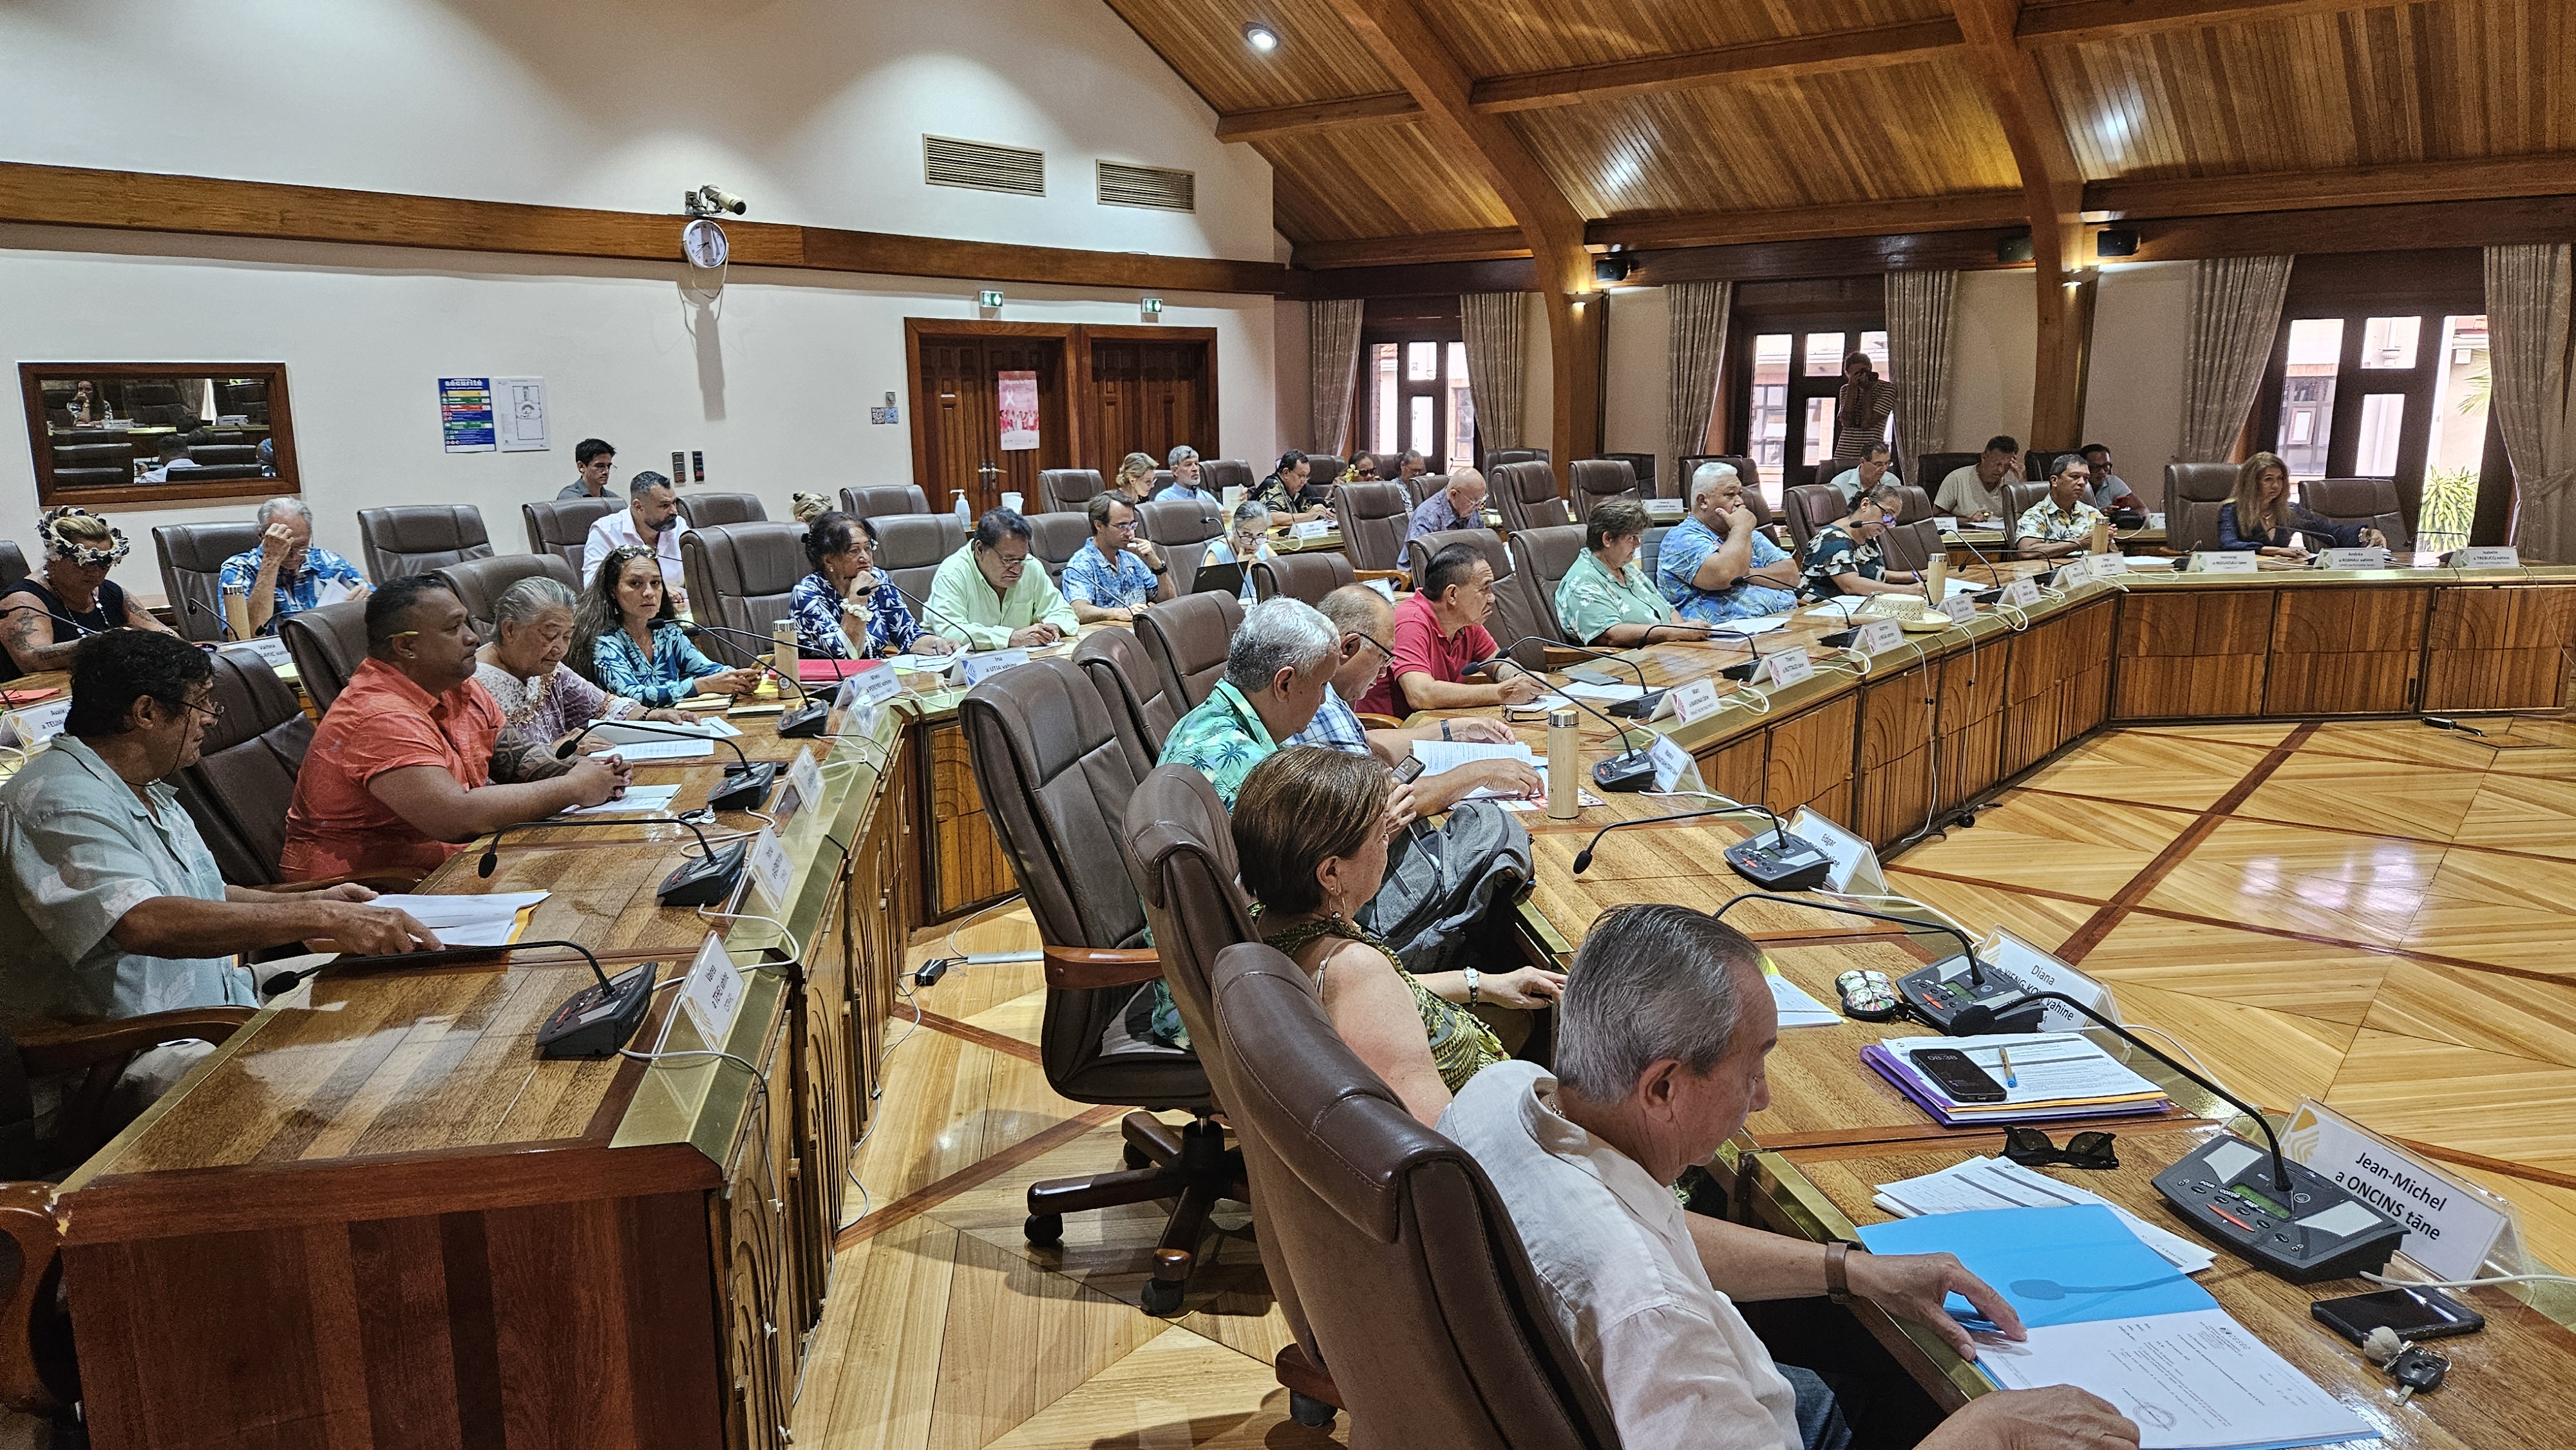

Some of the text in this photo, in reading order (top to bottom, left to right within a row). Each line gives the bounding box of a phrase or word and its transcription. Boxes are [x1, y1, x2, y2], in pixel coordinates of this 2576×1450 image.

[1821, 833, 1837, 847] Edgar
[2031, 965, 2055, 986] Diana
[712, 1001, 717, 1009] a
[2046, 998, 2074, 1021] vahine
[2355, 1152, 2447, 1212] Jean-Michel
[2334, 1171, 2440, 1240] a ONCINS tāne
